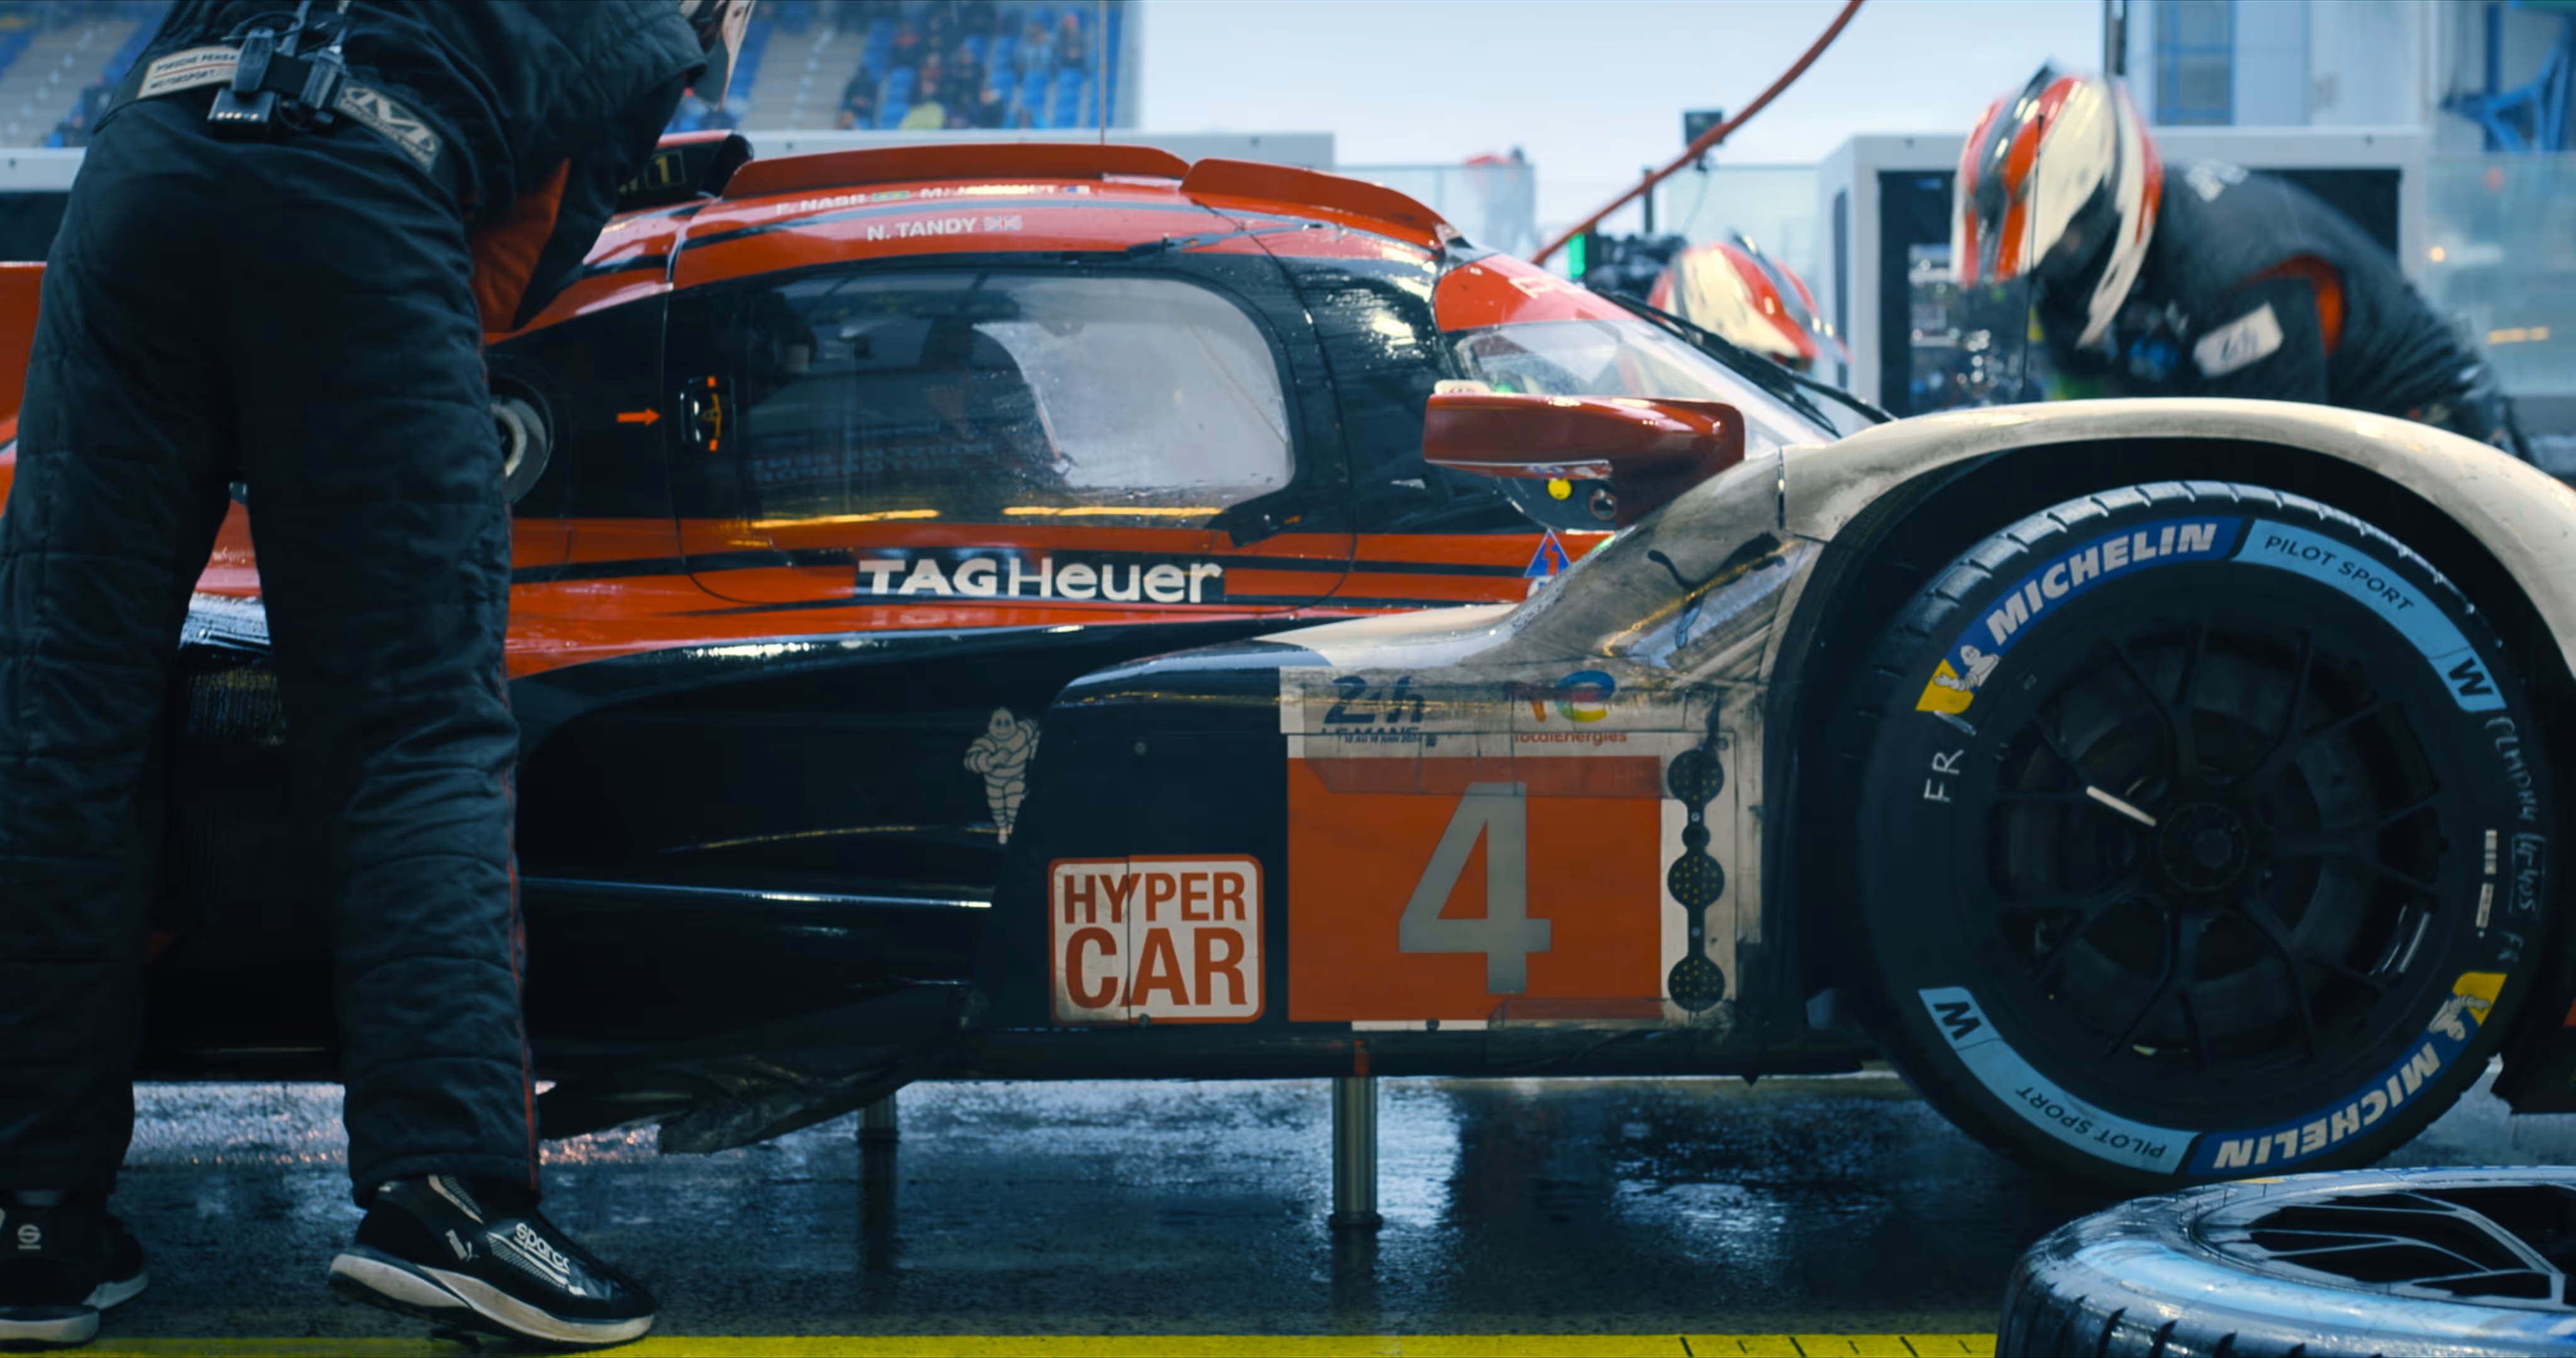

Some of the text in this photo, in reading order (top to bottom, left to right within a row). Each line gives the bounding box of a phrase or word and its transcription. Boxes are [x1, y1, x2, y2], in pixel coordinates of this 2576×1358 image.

[799, 194, 866, 211] NASR
[867, 217, 977, 241] N. TANDY
[1986, 523, 2218, 646] MICHELIN
[2264, 535, 2415, 612] PILOT SPORT
[2448, 657, 2494, 697] W
[1923, 748, 1964, 803] FR
[1063, 871, 1246, 924] HYPER
[1399, 783, 1552, 994] 4
[1065, 926, 1248, 1009] CAR
[2015, 1085, 2167, 1159] PILOT SPORT
[2212, 1041, 2441, 1169] MICHELIN
